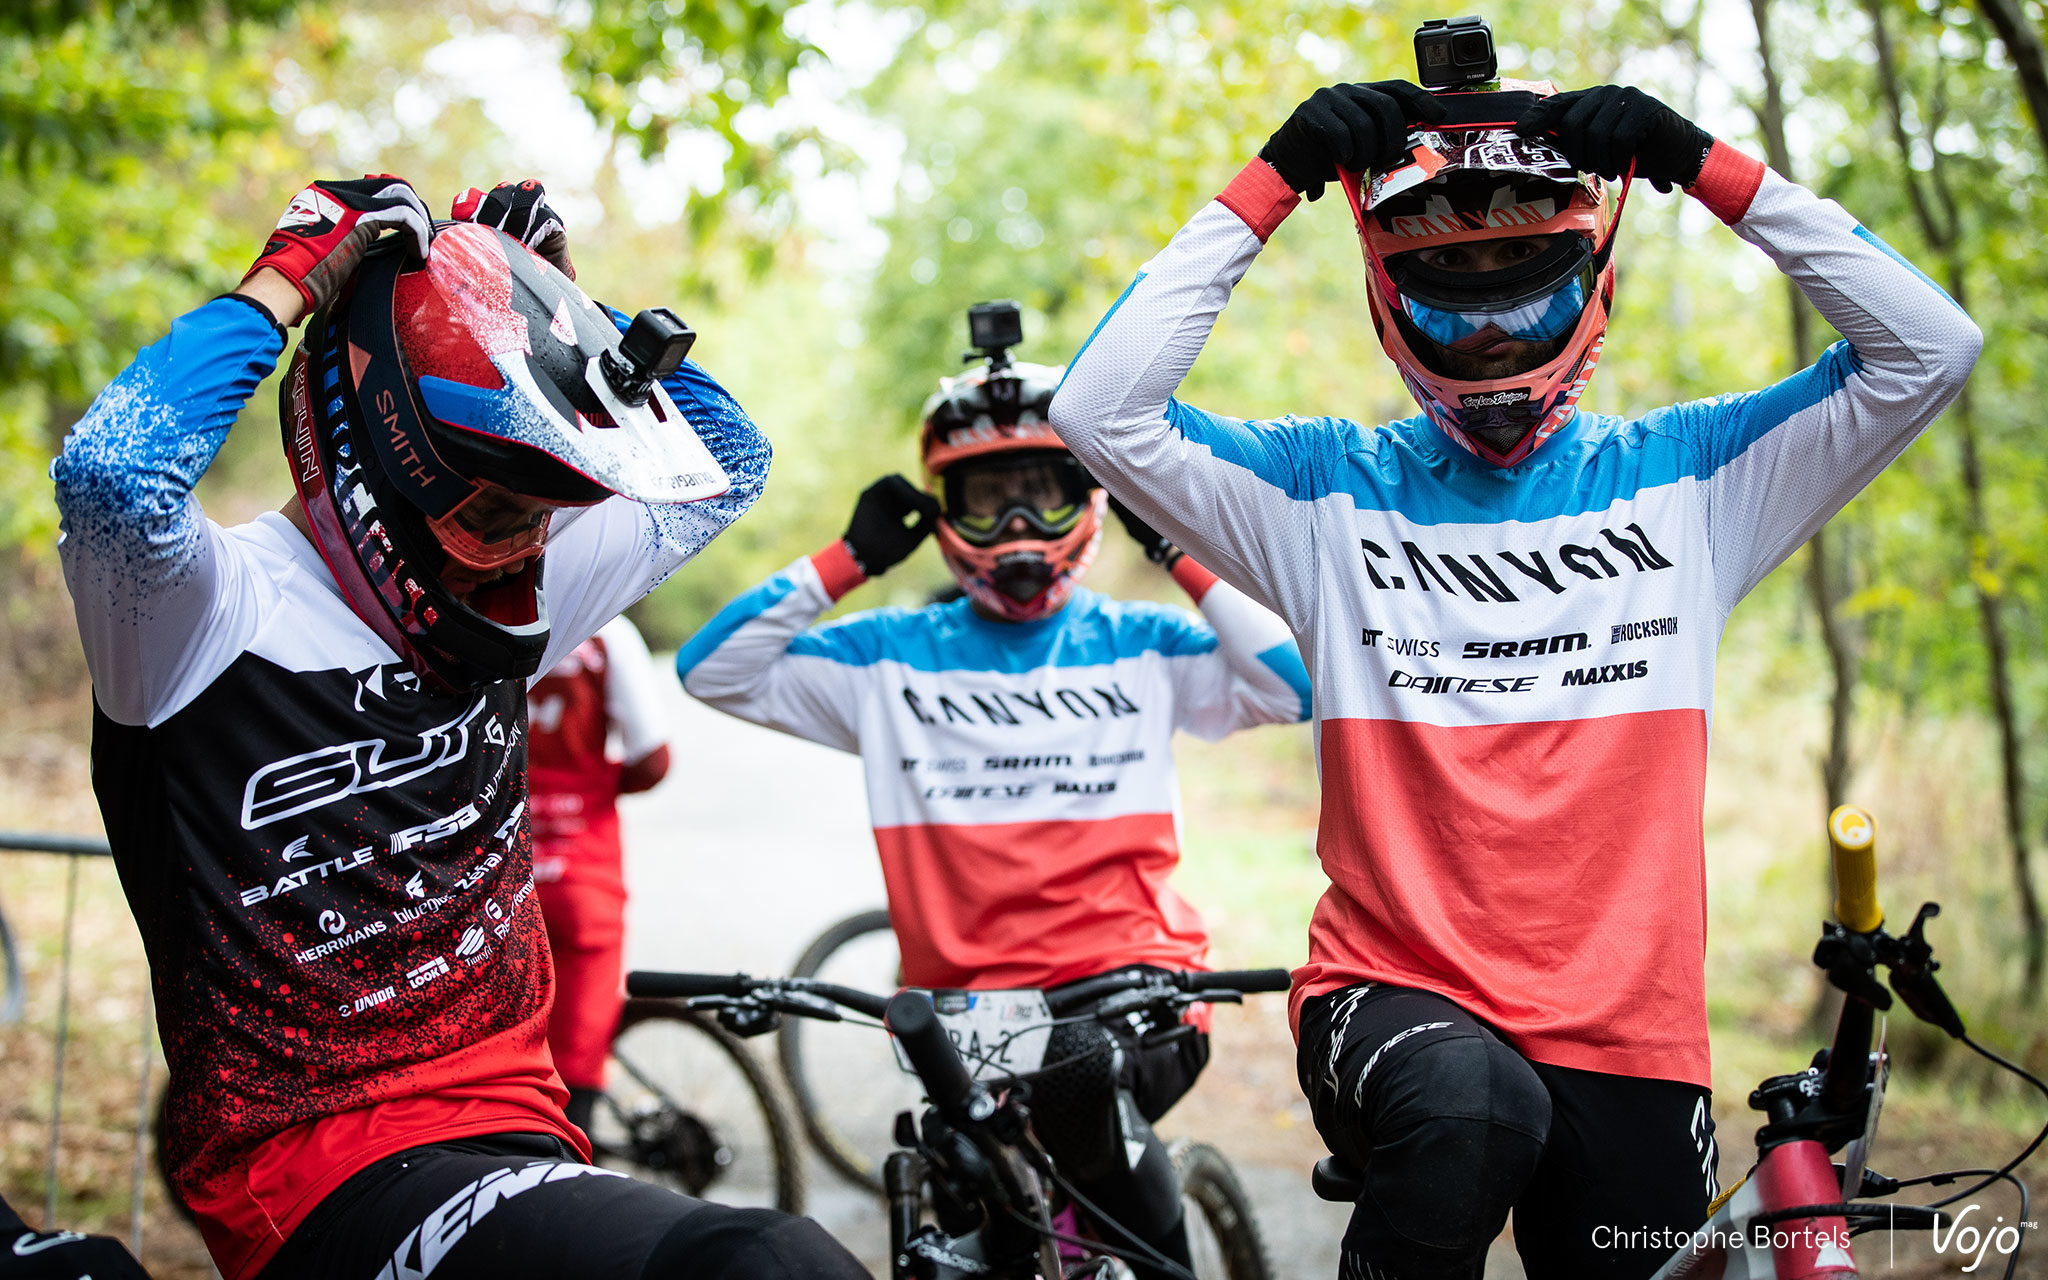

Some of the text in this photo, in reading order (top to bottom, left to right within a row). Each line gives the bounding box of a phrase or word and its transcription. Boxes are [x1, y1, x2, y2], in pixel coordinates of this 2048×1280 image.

[1394, 203, 1547, 239] CANYON
[376, 388, 436, 488] SMITH
[1361, 522, 1674, 602] CANYON
[1362, 628, 1383, 648] DT
[1387, 638, 1441, 658] SWISS
[1388, 660, 1649, 694] DAINESE MAXXIS
[902, 682, 1139, 725] CANYON
[240, 846, 375, 907] BATTLE
[294, 920, 388, 965] HERRMANS
[354, 985, 397, 1013] UNIOR
[409, 967, 441, 989] LOOK
